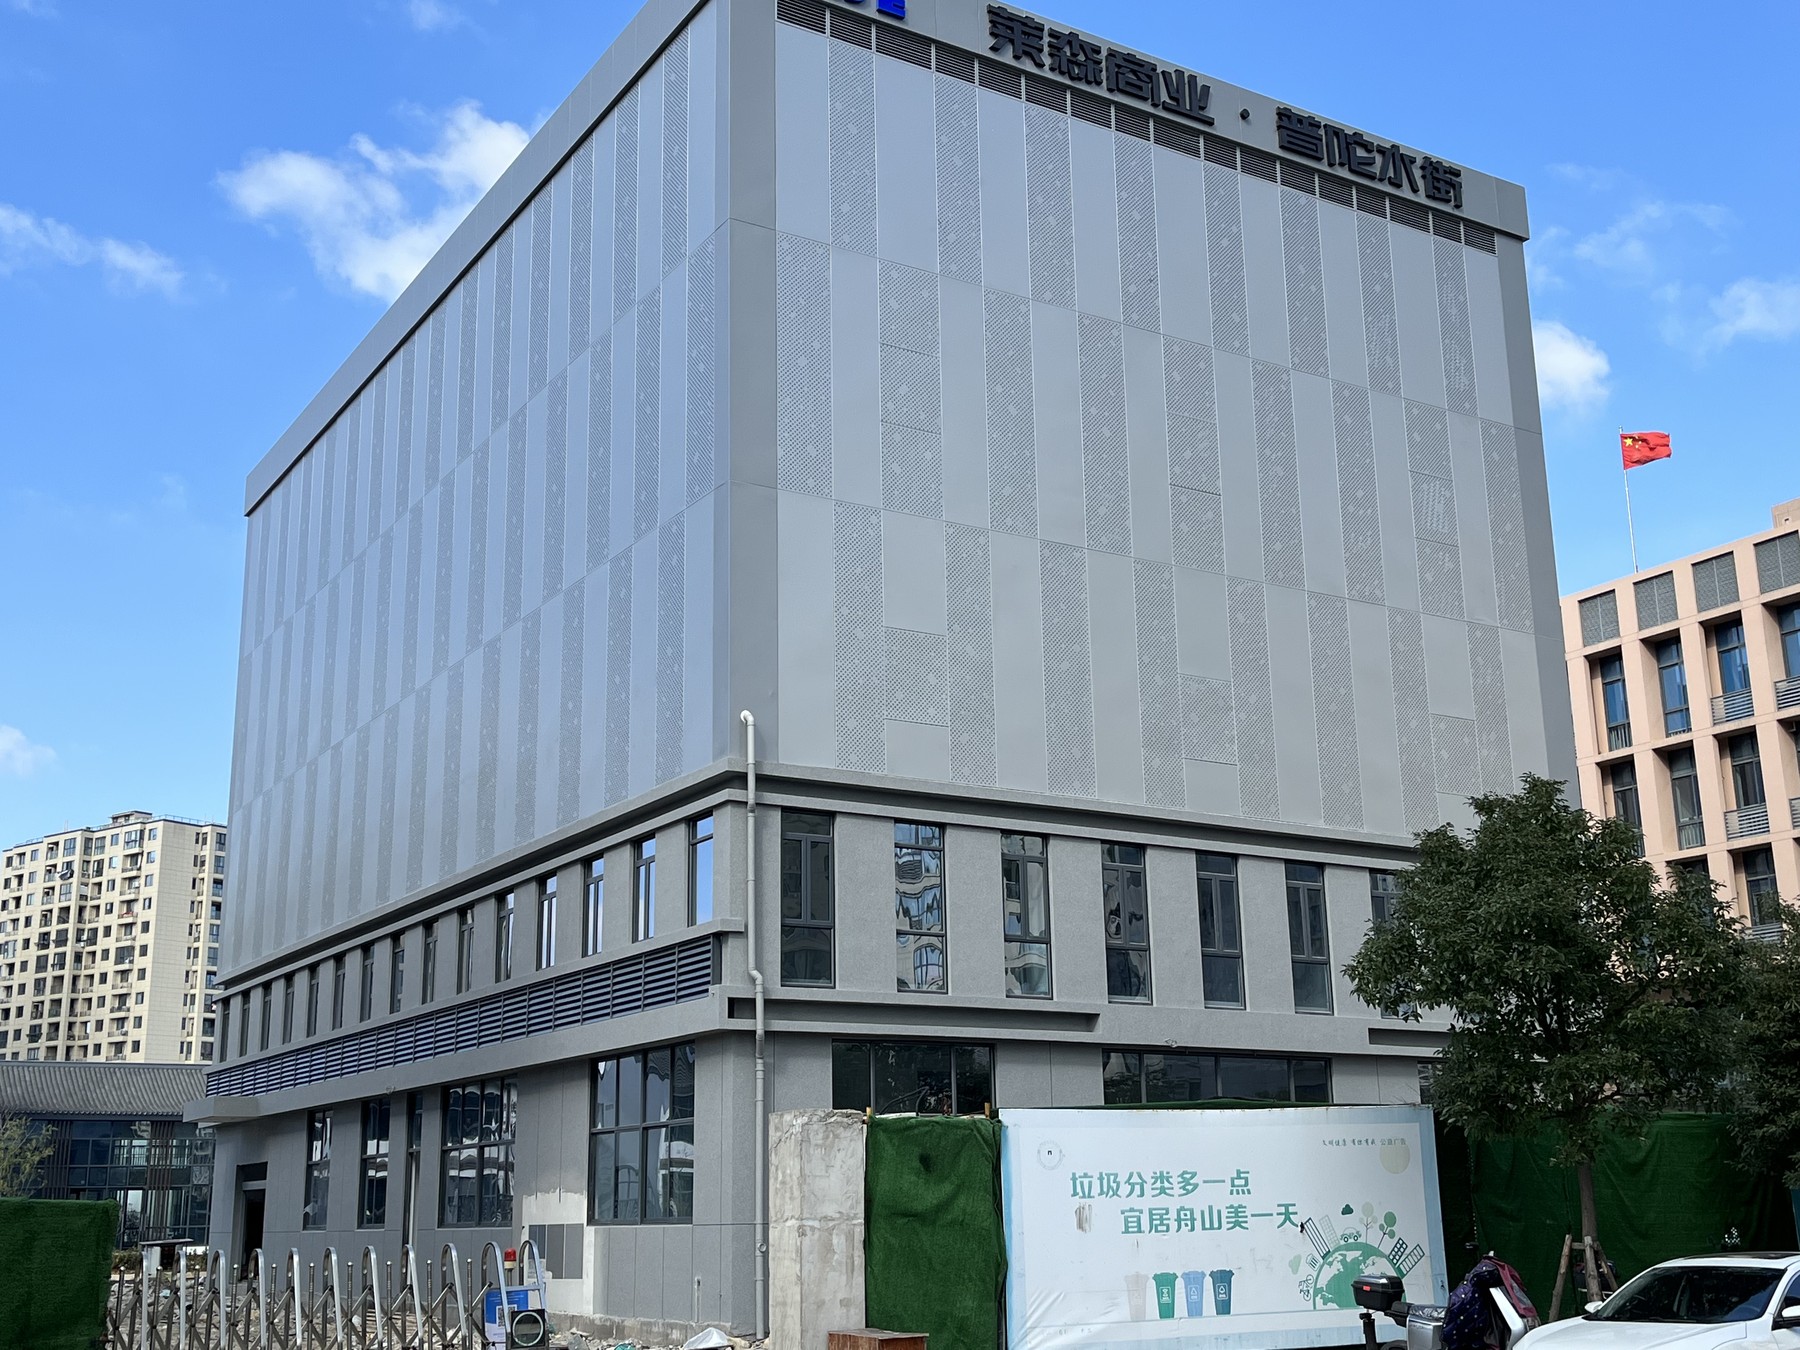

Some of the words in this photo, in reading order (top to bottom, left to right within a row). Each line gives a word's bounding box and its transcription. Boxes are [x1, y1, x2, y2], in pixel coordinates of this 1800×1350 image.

[1070, 1168, 1251, 1199] 垃圾分类多一点
[1120, 1203, 1299, 1234] 宜居舟山美一天
